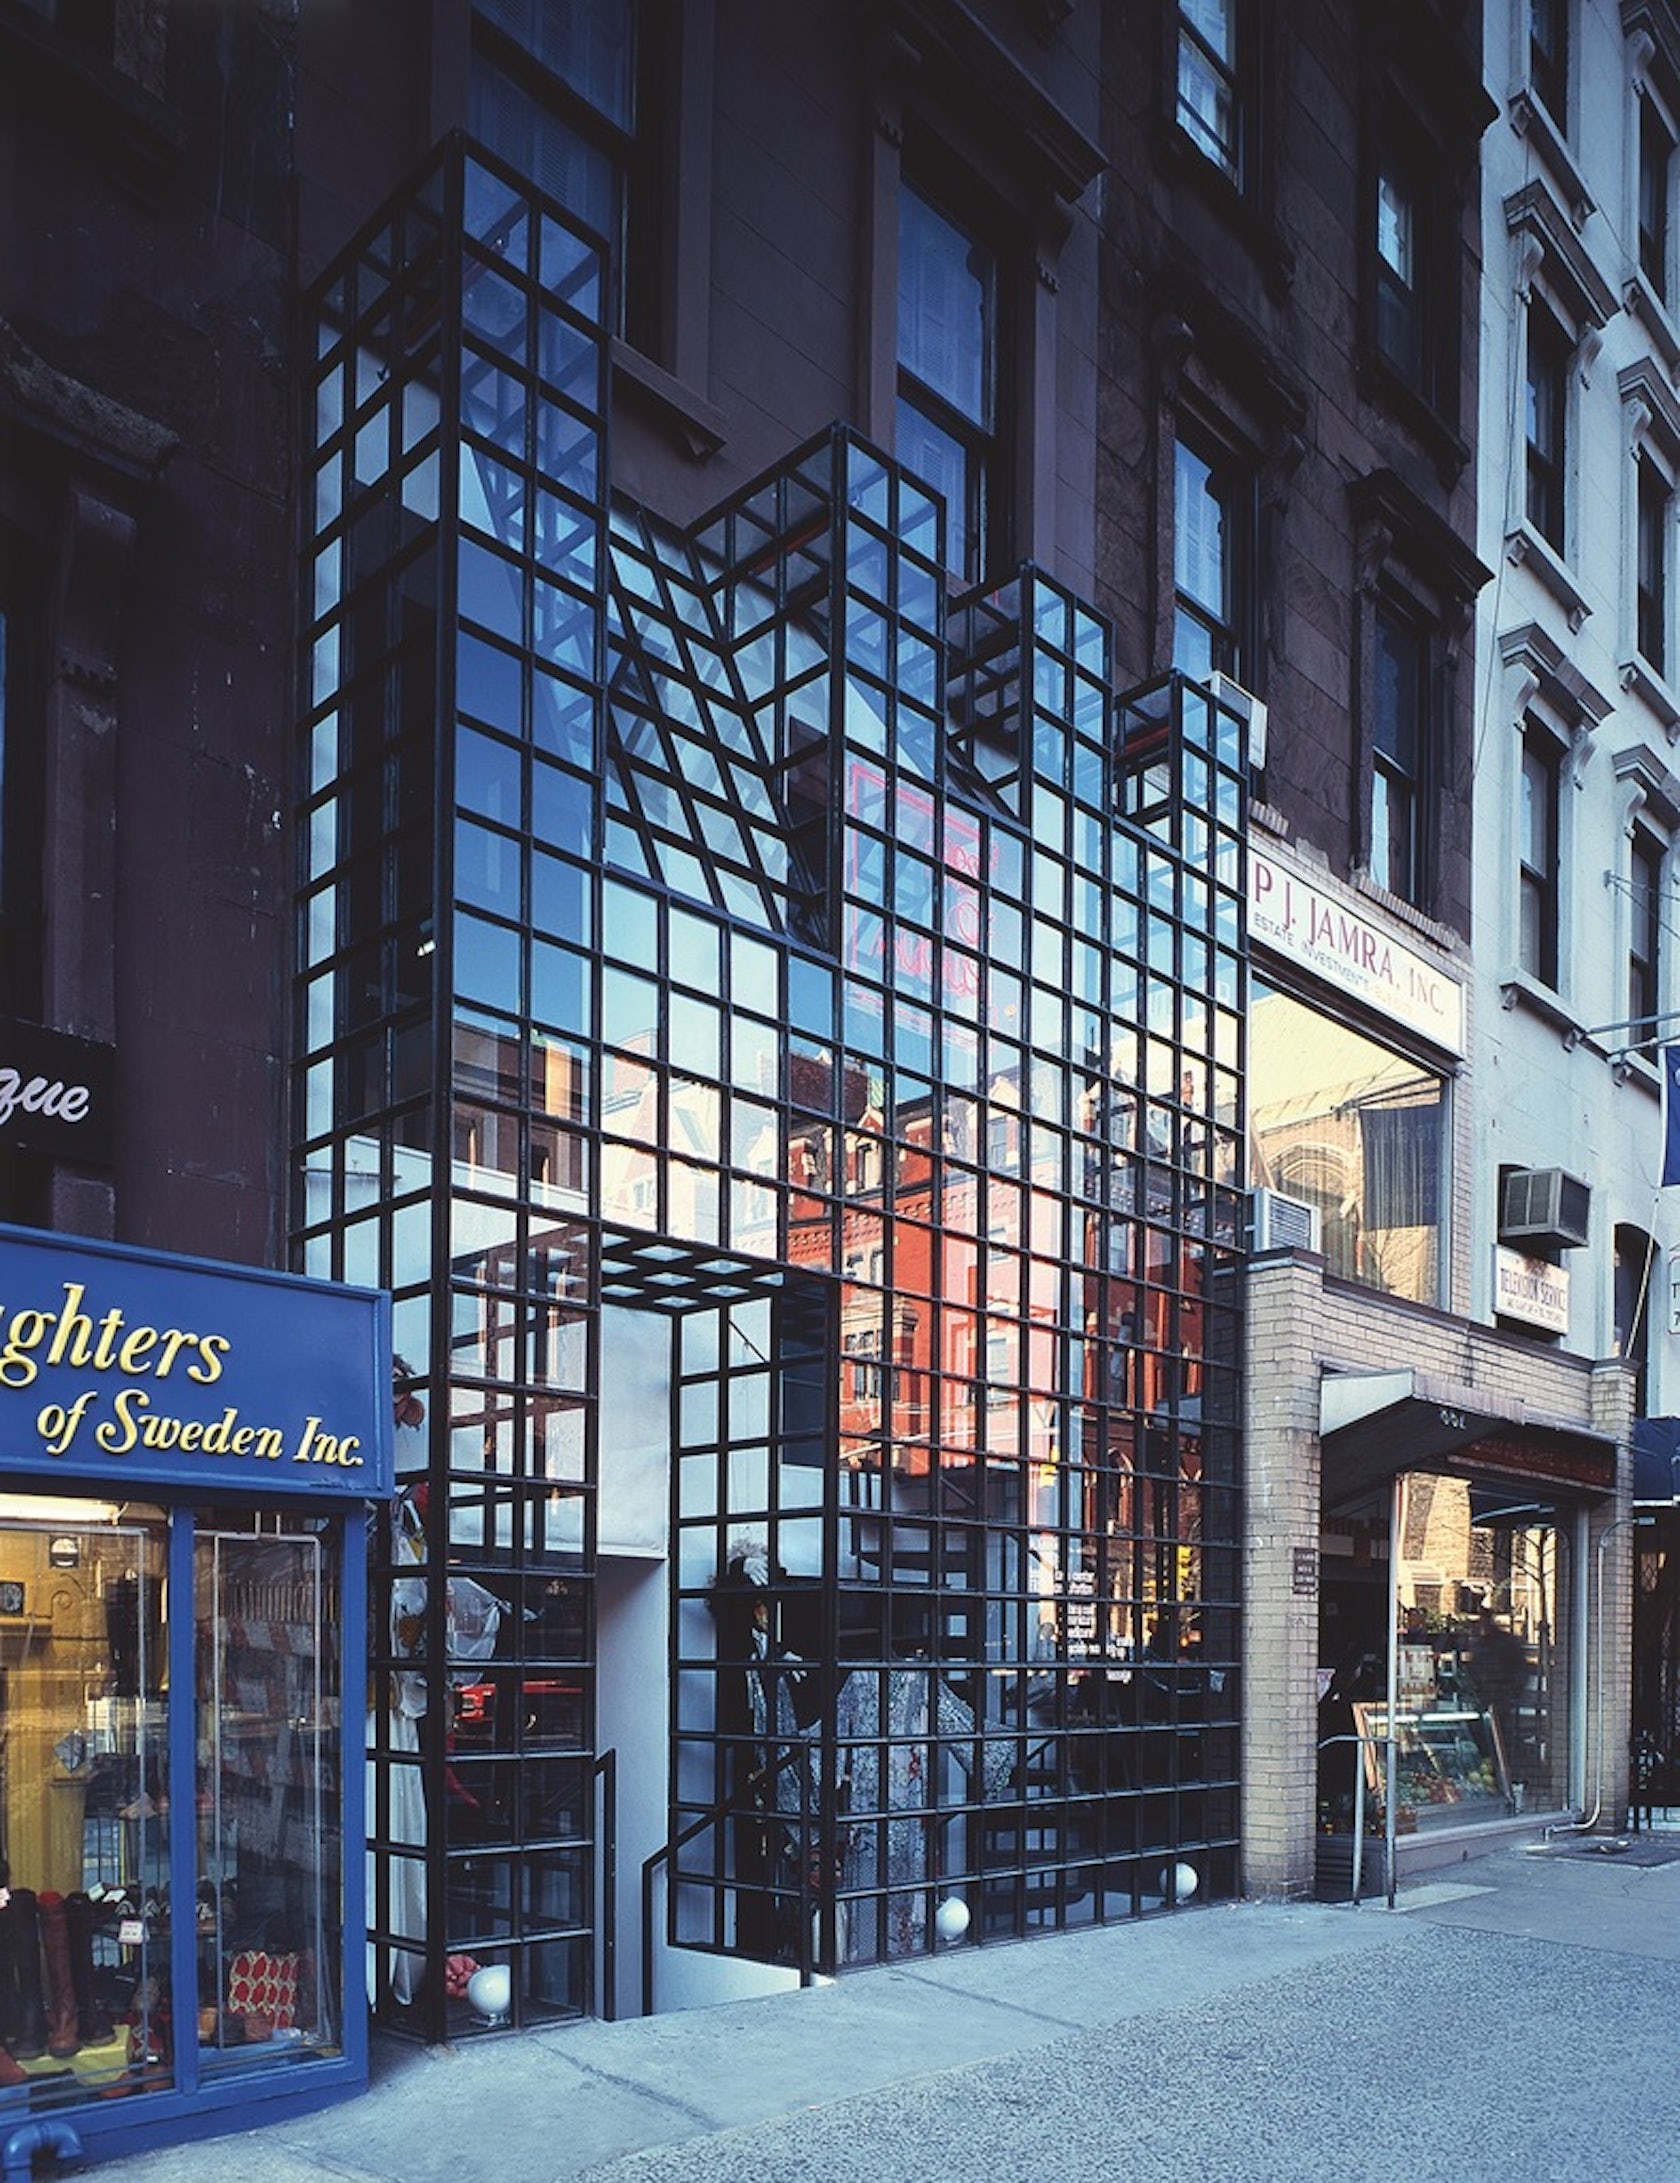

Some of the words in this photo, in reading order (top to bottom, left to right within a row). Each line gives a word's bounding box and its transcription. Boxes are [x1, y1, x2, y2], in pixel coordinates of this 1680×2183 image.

[1253, 911, 1295, 948] ESTATE
[1409, 966, 1445, 1016] INC.
[1540, 1280, 1567, 1312] SERVICE
[0, 1281, 232, 1388] ghters
[37, 1390, 99, 1456] of
[95, 1388, 283, 1460] Sweden
[293, 1415, 365, 1468] Inc.
